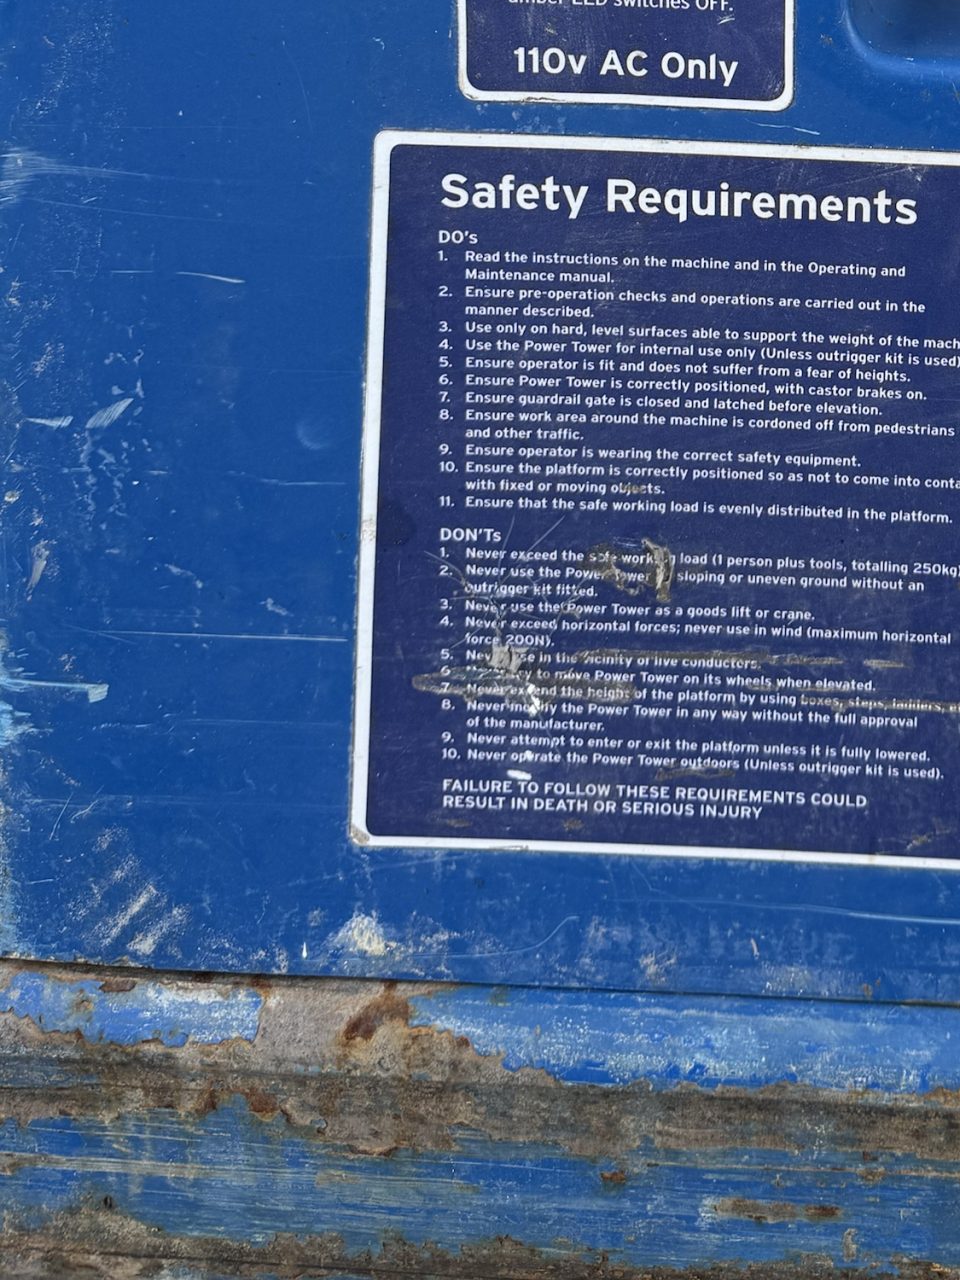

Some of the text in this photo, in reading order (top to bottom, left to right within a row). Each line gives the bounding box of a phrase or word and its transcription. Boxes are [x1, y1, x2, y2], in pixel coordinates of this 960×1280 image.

[513, 47, 739, 87] 110v AC Only
[441, 174, 918, 225] Safety Requirements
[438, 250, 906, 278] 1. Read the instructions on the machine and in the Operating and
[442, 778, 867, 807] FAILURE TO FOLLOW THESE REQUIREMENTS COULD
[442, 795, 763, 819] RESULT IN DEATH OR SERIOUS INJURY
